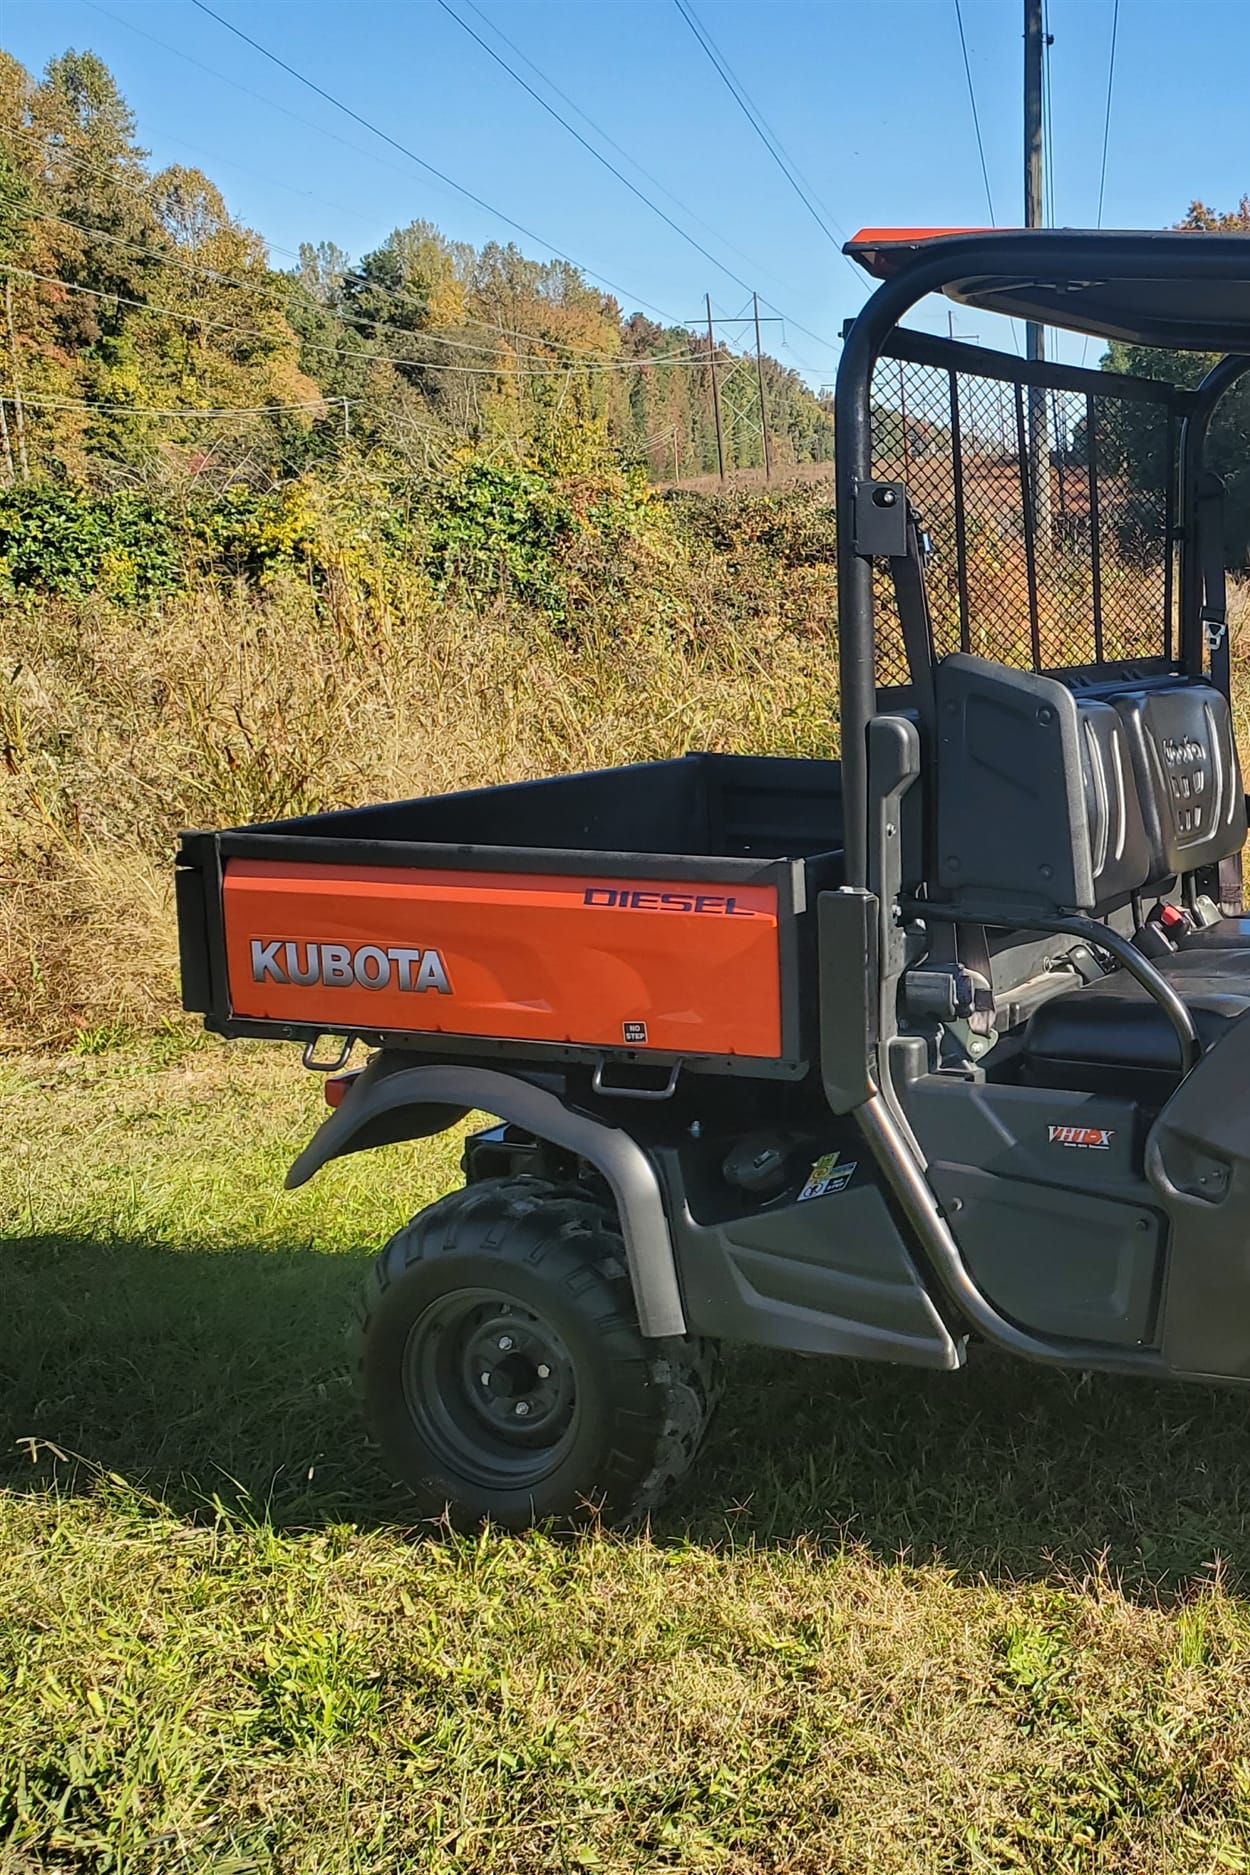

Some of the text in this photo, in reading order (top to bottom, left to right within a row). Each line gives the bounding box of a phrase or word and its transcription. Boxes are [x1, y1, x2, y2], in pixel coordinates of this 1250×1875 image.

[583, 888, 755, 916] DIESEL
[250, 939, 454, 995] KUBOTA
[625, 1032, 645, 1041] STEP
